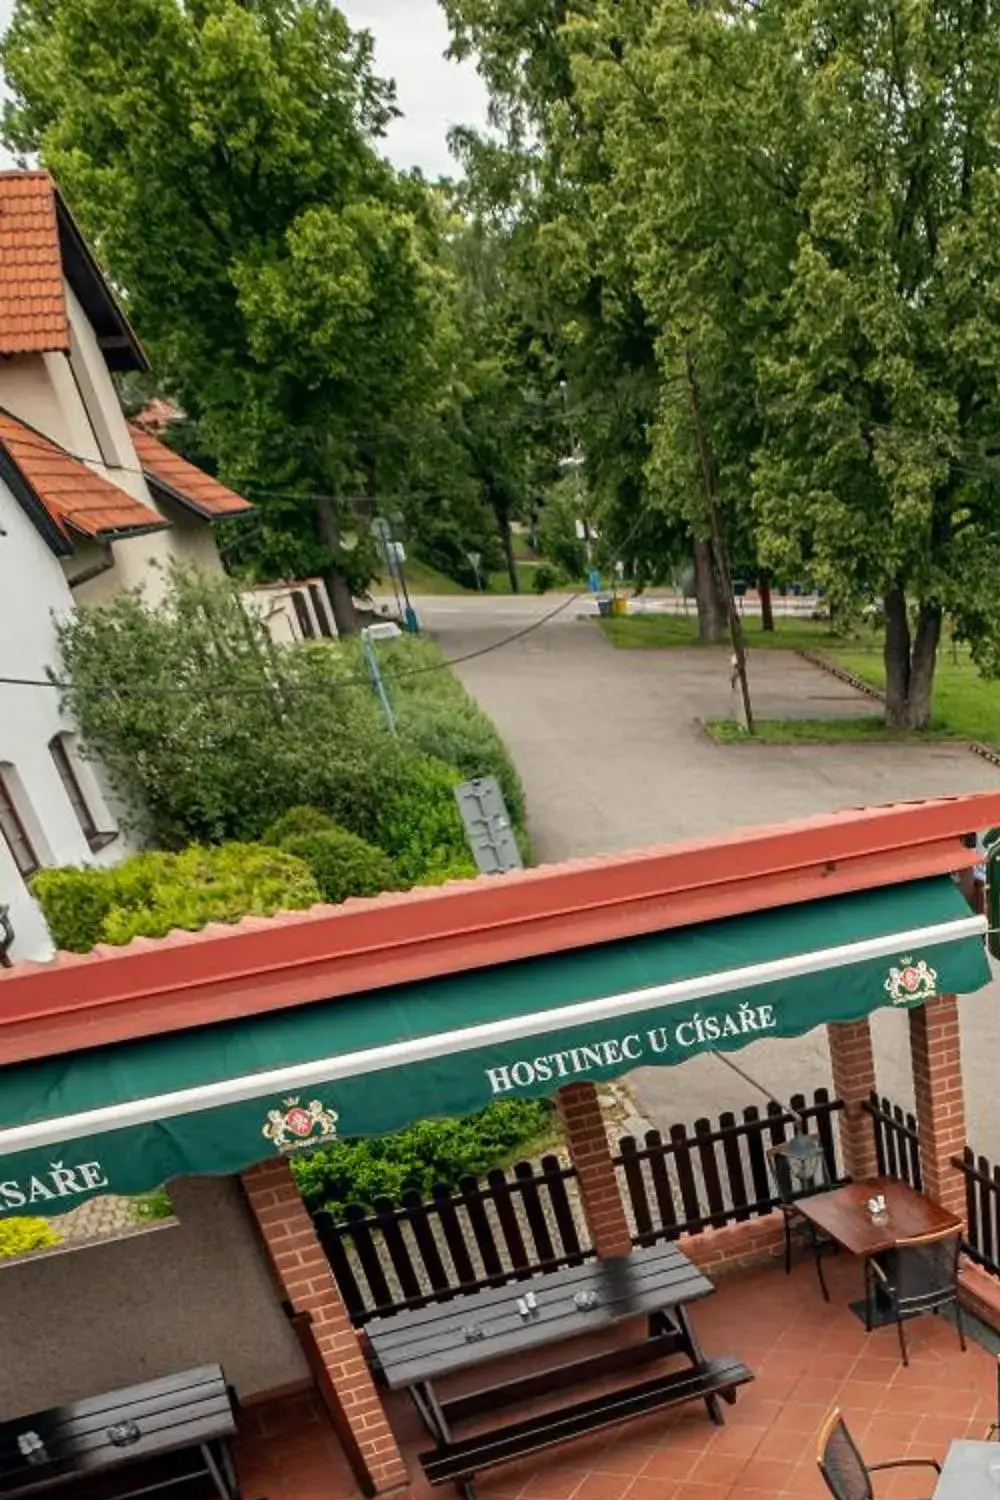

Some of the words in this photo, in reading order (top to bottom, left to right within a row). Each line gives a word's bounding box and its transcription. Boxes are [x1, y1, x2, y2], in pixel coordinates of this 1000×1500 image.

[485, 1034, 643, 1094] HOSTINEC
[648, 1026, 669, 1053] U
[675, 1001, 777, 1048] CÍSAŘE
[0, 1159, 109, 1212] SAŘE
